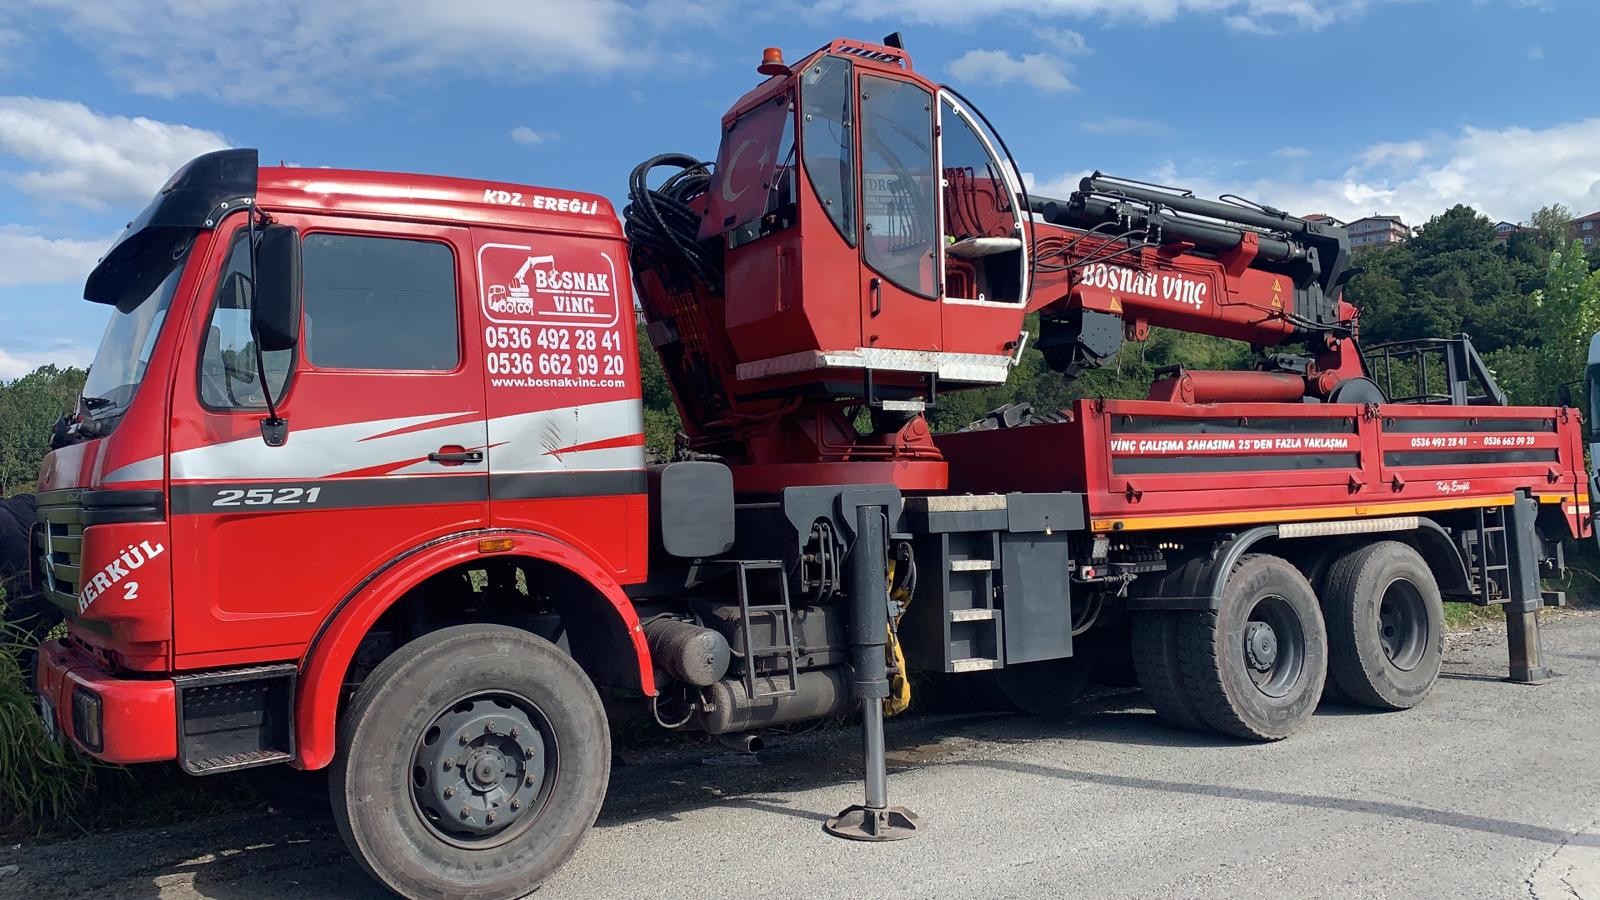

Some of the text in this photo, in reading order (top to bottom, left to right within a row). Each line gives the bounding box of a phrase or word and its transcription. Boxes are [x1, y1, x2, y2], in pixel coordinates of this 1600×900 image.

[483, 189, 598, 215] KDZ. EREĞLİ
[1080, 263, 1158, 297] BOŞNAK
[485, 326, 621, 351] 0536 492 28 41
[487, 352, 624, 376] 0536 662 09 20
[491, 376, 625, 388] www.bosnakvinc.com
[1139, 440, 1184, 454] ÇALIŞMA
[1186, 439, 1235, 451] SAHASINA
[1275, 438, 1301, 449] FAZLA
[1303, 437, 1348, 450] YAKLAŞMA
[1411, 437, 1430, 448] 0536
[1431, 437, 1446, 447] 492
[1447, 437, 1457, 447] 28
[1458, 437, 1467, 446] 41
[1483, 436, 1501, 446] 0536
[1502, 436, 1515, 446] 662
[1516, 436, 1525, 446] 09
[1526, 436, 1535, 445] 20
[212, 487, 321, 507] 2521
[77, 539, 165, 615] HERKÜL
[123, 581, 139, 600] 2
